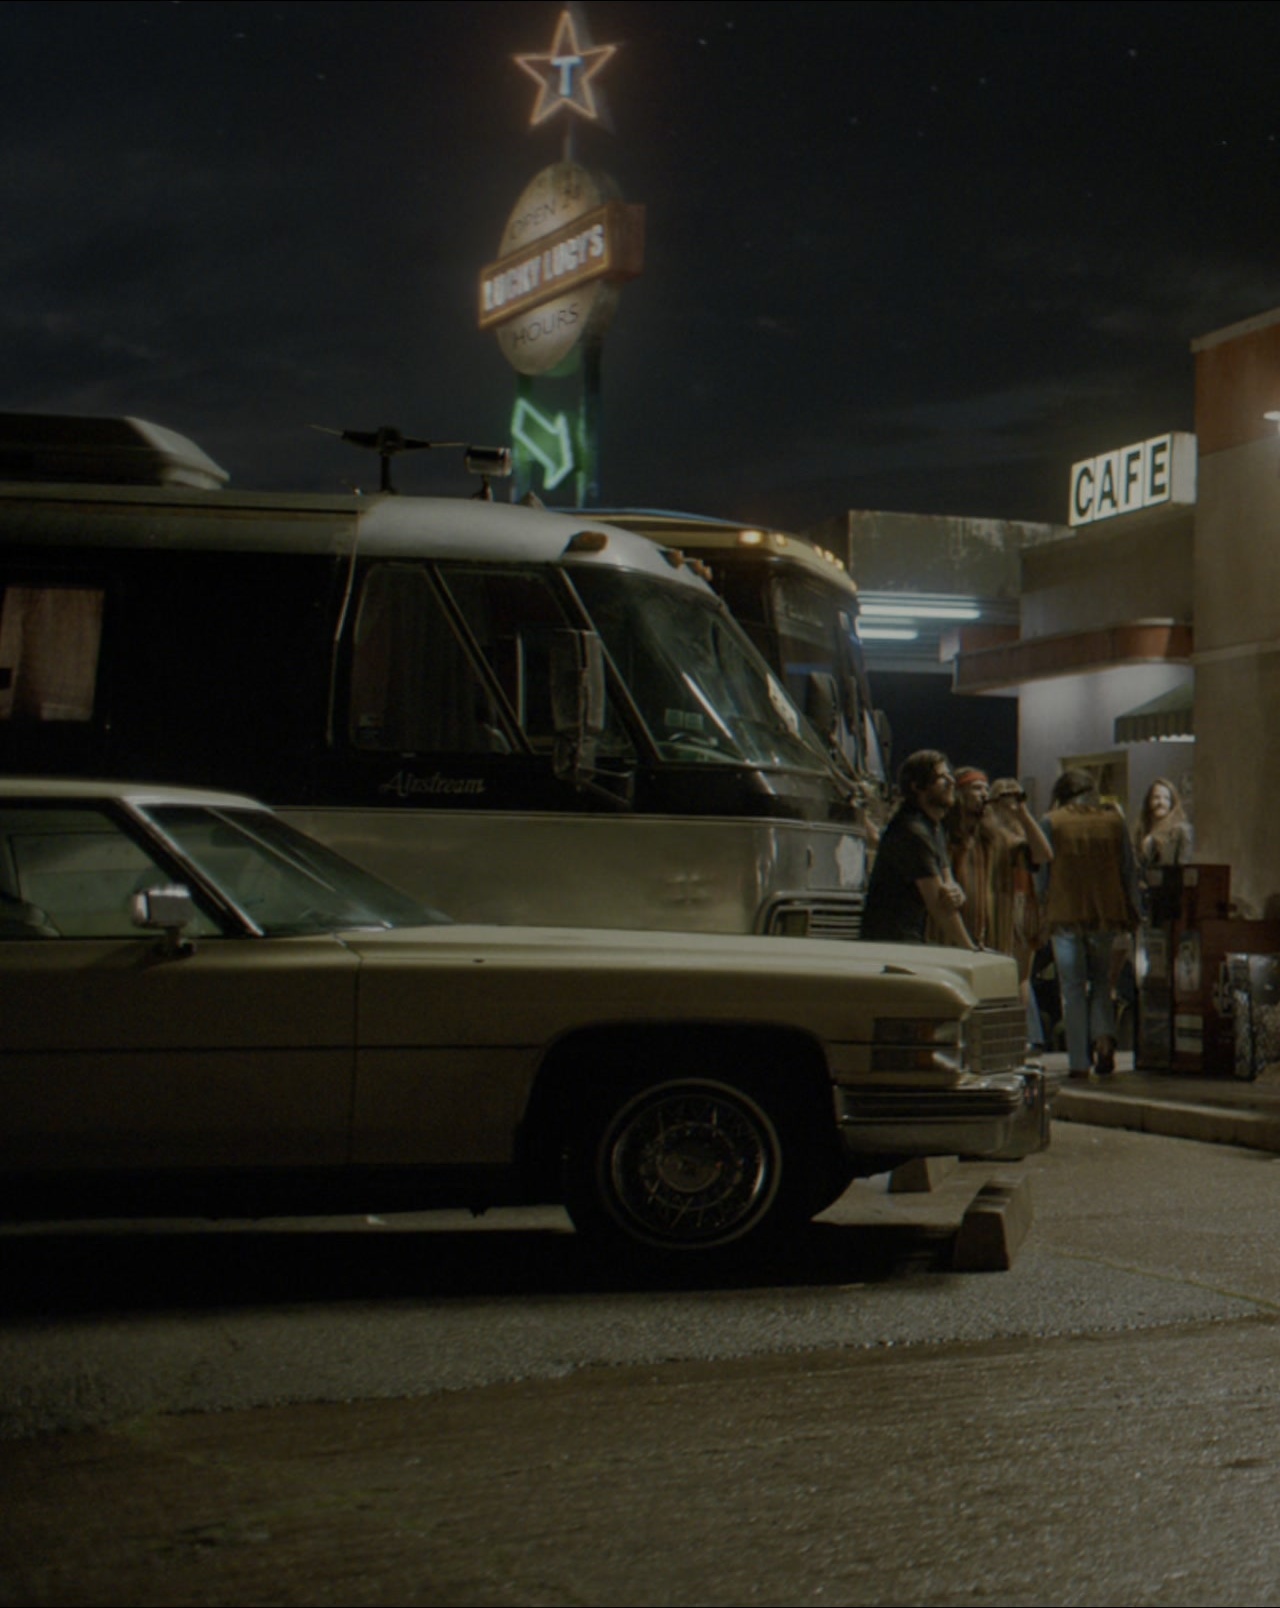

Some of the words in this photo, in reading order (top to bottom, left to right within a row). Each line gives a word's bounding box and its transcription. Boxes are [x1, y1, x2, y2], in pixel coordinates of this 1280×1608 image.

[550, 55, 583, 97] T
[483, 255, 542, 311] LUCKY
[512, 304, 578, 348] HOURS
[1075, 442, 1168, 517] CAFE
[378, 770, 486, 797] Airstream
